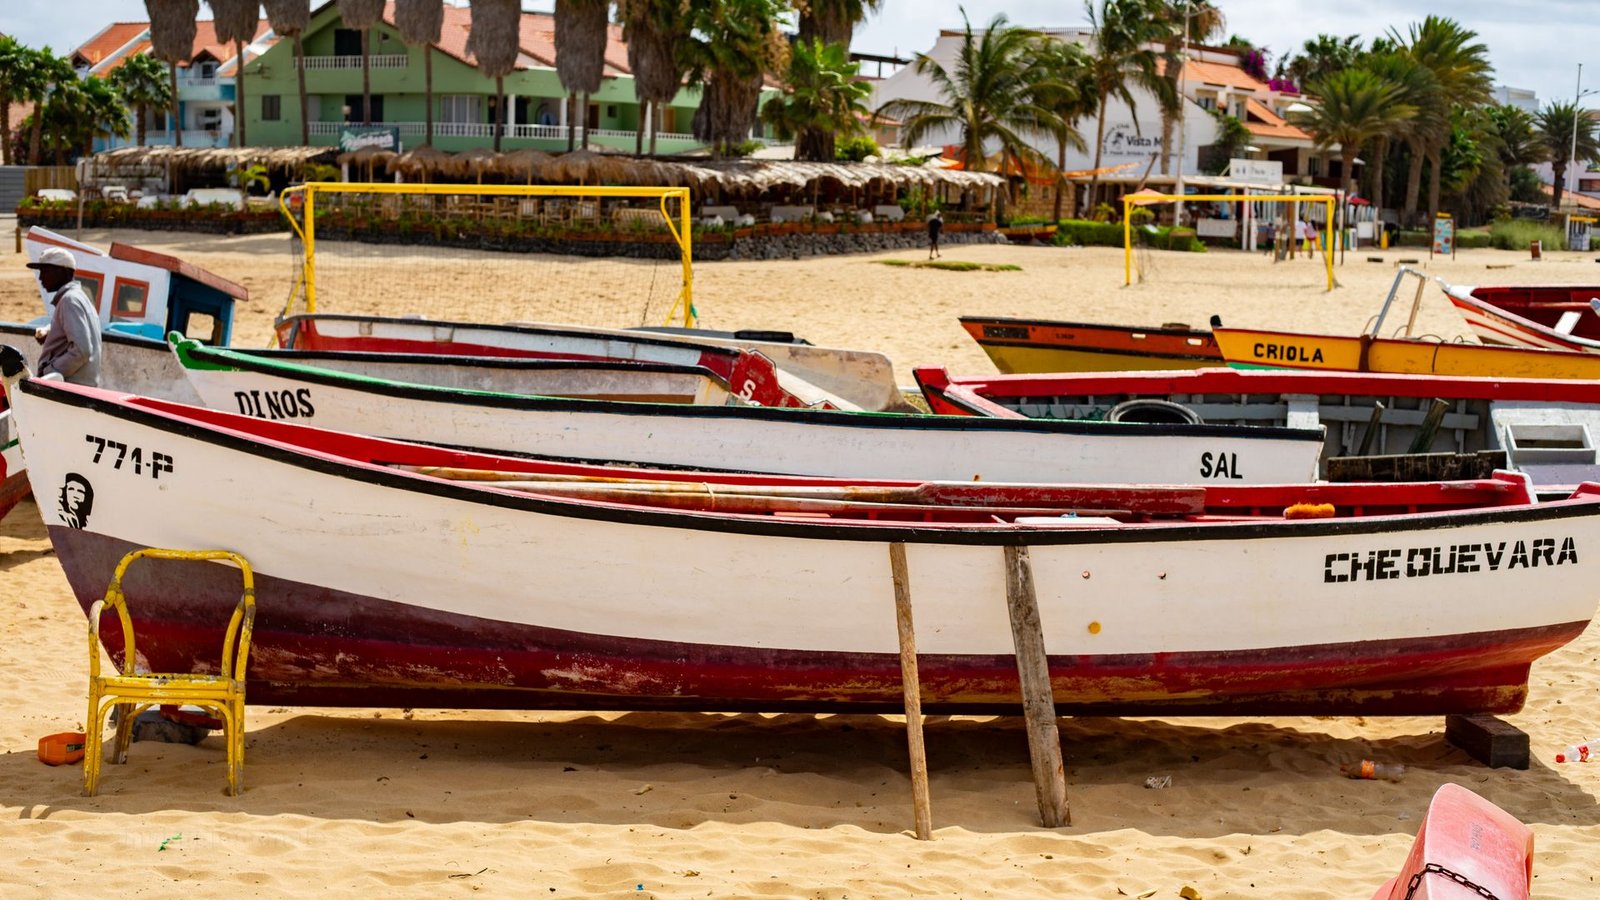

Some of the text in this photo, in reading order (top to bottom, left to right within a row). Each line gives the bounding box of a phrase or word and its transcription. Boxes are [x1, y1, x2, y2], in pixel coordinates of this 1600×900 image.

[1126, 135, 1152, 147] Vista
[1253, 342, 1324, 364] CRIOLA
[234, 388, 315, 420] DINOS
[85, 434, 174, 479] 771-P
[1199, 451, 1244, 480] SAL
[1323, 549, 1402, 584] CHE
